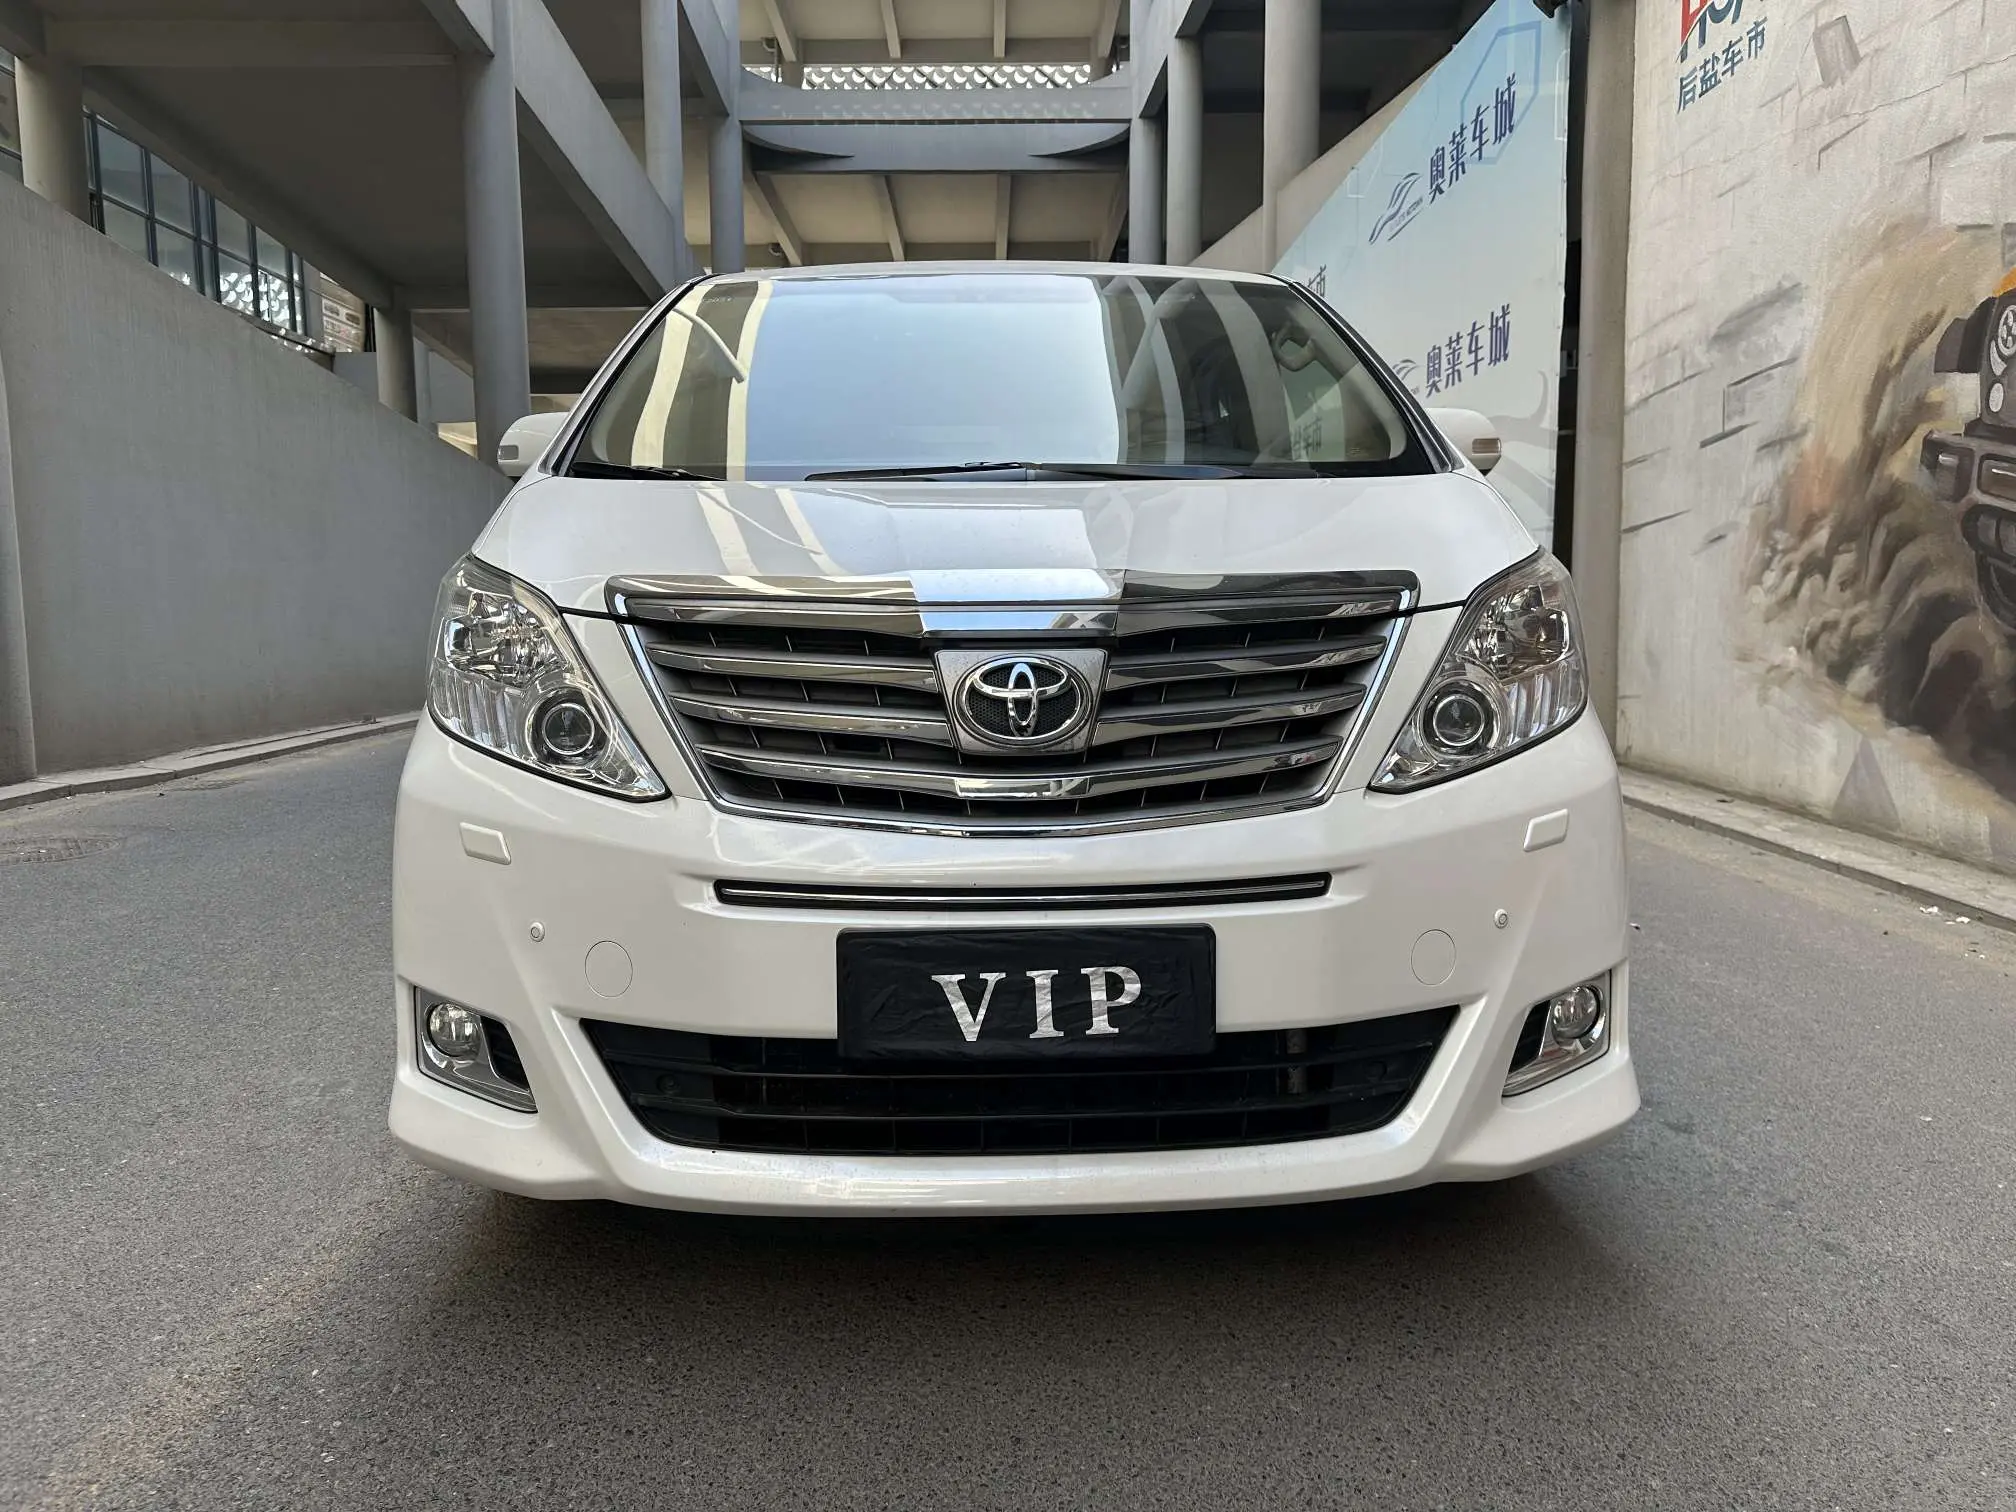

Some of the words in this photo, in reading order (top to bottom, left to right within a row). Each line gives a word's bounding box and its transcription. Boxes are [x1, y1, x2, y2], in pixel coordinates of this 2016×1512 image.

[1677, 16, 1768, 114] 后盐车市
[1429, 72, 1517, 204] 奥莱车城
[1426, 303, 1510, 398] 奥莱车城
[931, 966, 1142, 1042] VIP
